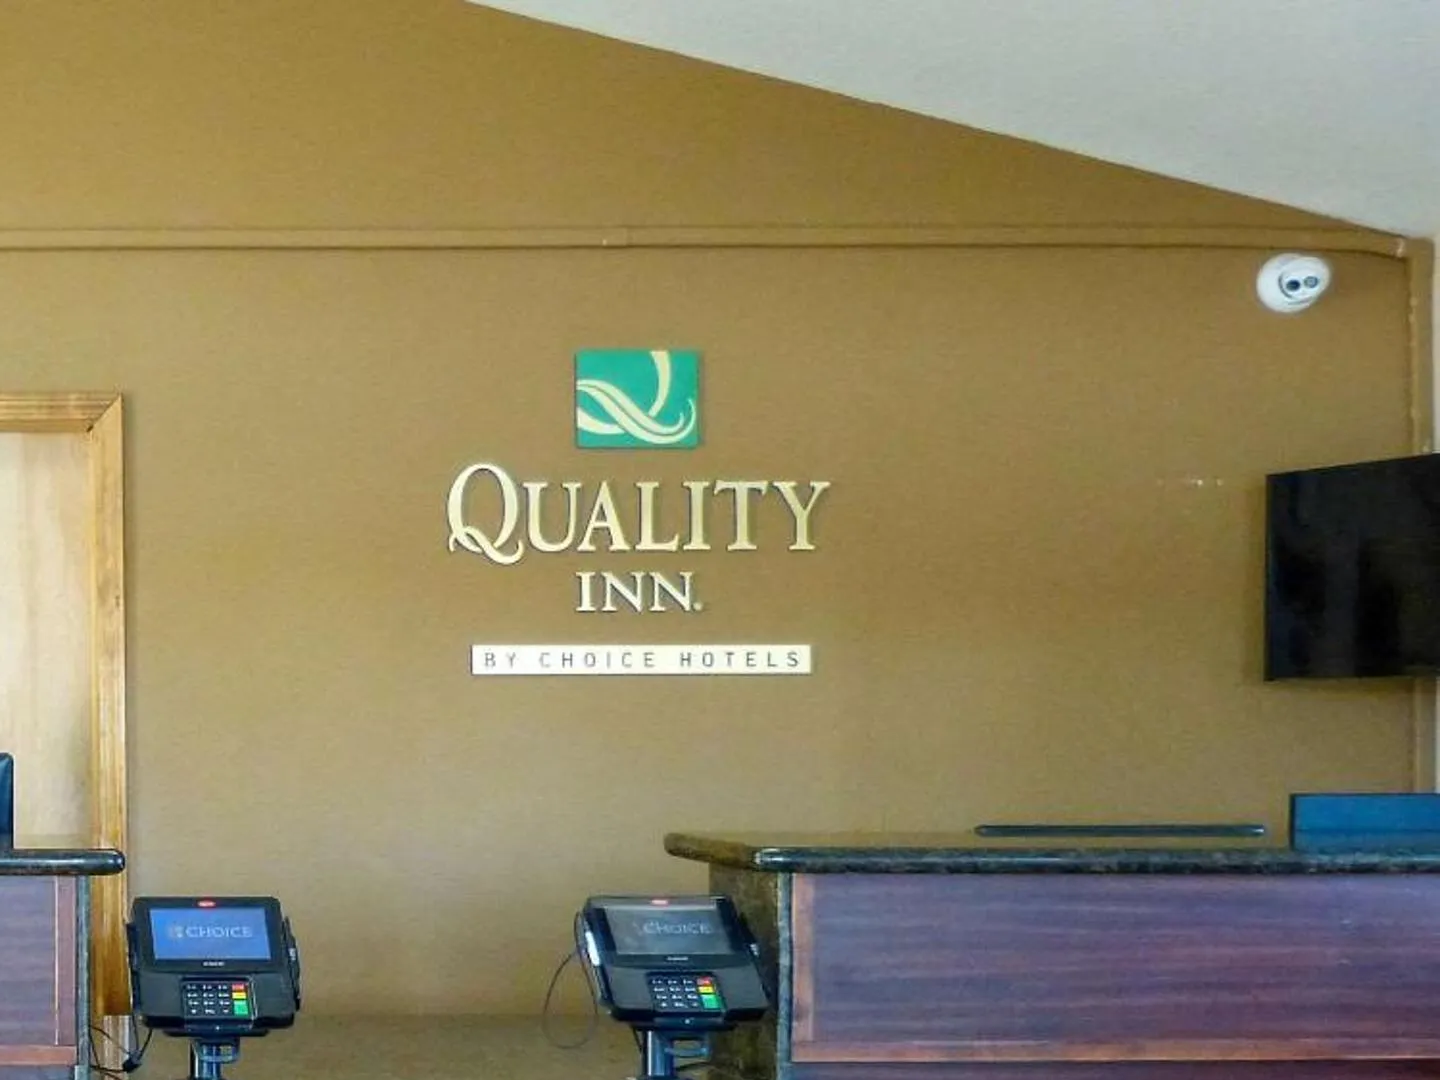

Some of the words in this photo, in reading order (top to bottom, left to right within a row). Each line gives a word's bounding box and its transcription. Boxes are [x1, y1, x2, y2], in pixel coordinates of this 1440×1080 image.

[446, 462, 832, 566] QUALITY
[483, 651, 519, 668] BY
[538, 651, 657, 668] CHOICE
[678, 651, 801, 668] HOTELS
[185, 925, 254, 939] CHOICE
[642, 919, 713, 936] CHOICE
